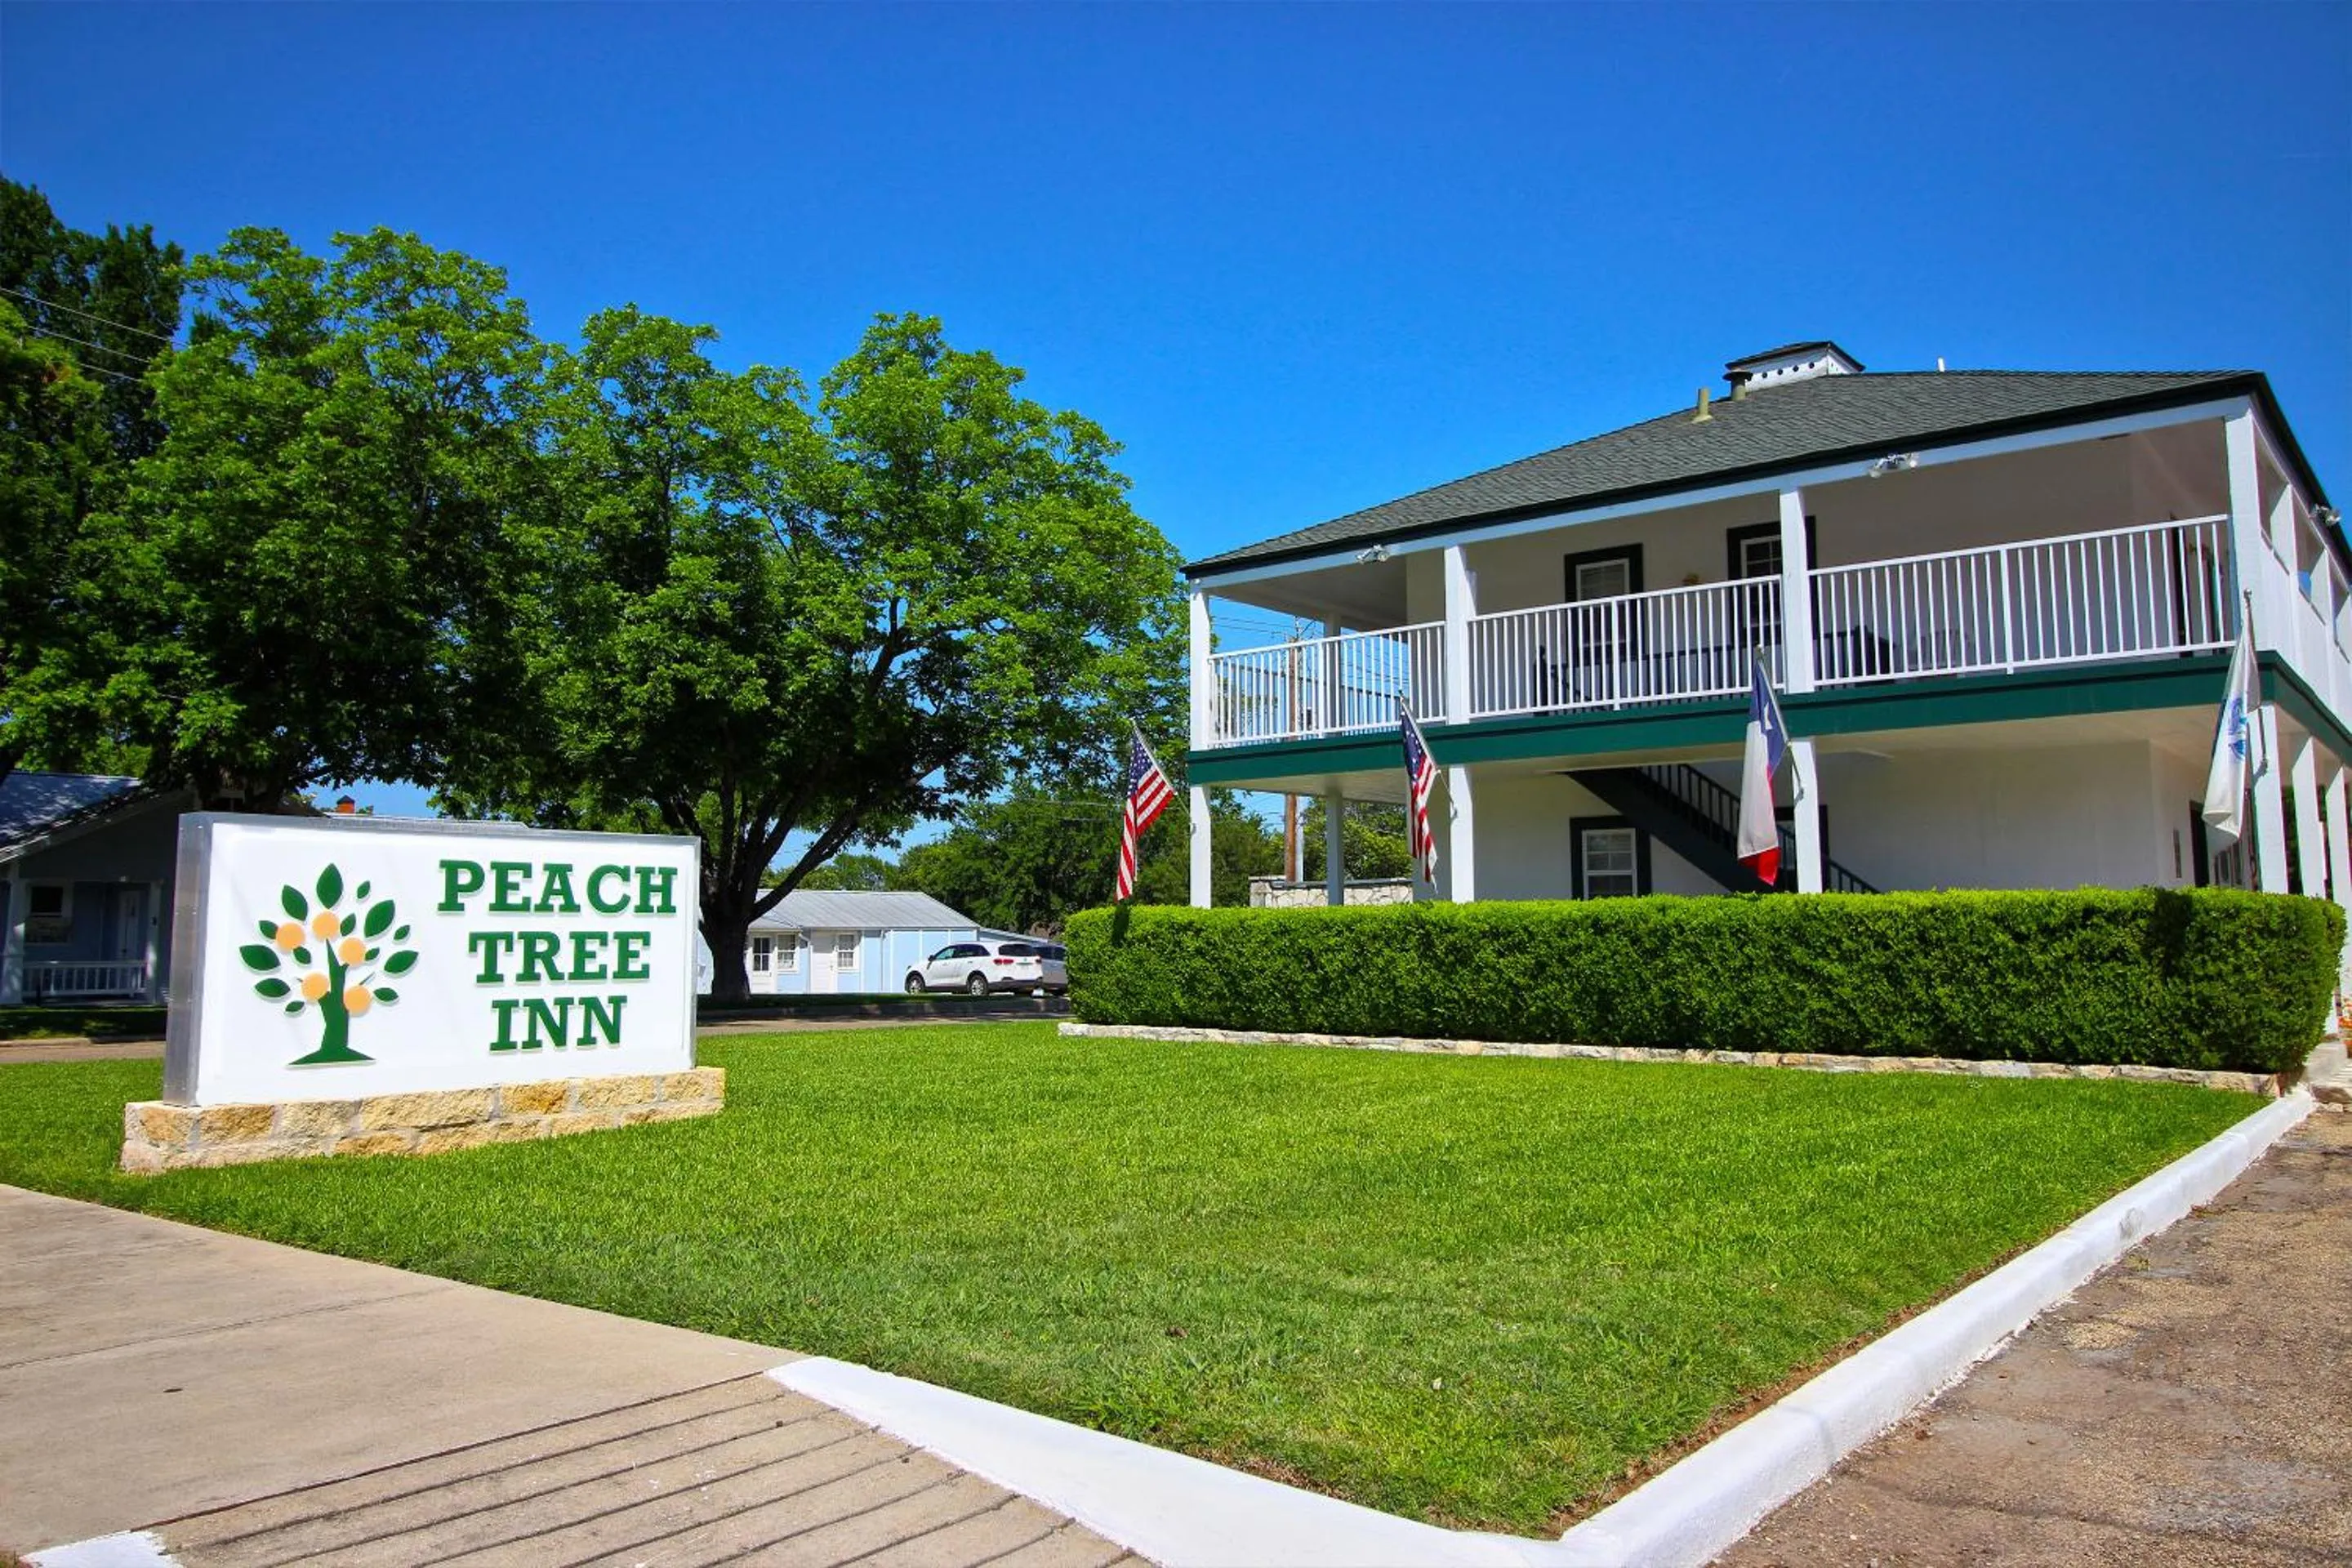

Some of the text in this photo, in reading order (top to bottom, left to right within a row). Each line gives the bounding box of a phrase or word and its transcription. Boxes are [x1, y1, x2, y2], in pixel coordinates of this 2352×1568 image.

[438, 859, 678, 913] PEACH
[468, 931, 651, 983] TREE
[489, 995, 628, 1051] INN
